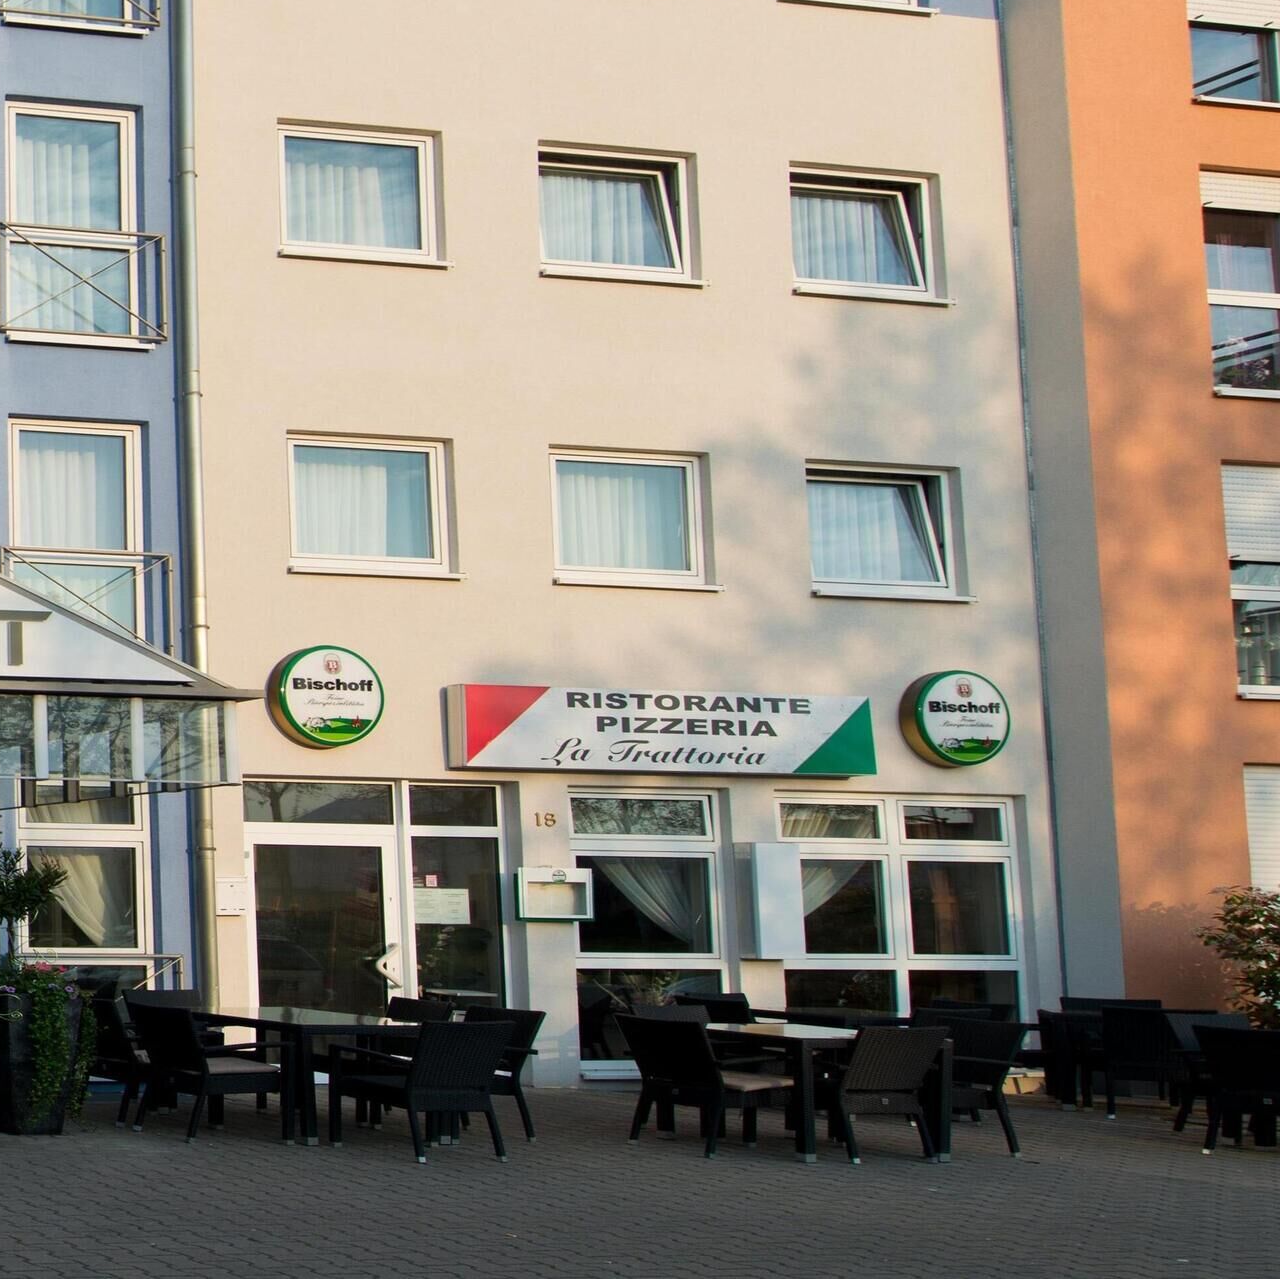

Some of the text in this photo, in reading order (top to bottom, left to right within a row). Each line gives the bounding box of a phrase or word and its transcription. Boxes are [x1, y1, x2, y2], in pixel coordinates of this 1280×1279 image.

[293, 677, 373, 692] Bischoff
[566, 692, 811, 714] RISTORANTE
[928, 701, 1000, 714] Bischoff
[596, 716, 778, 737] PIZZERIA
[541, 737, 768, 766] La Trattoria
[534, 812, 557, 827] 18
